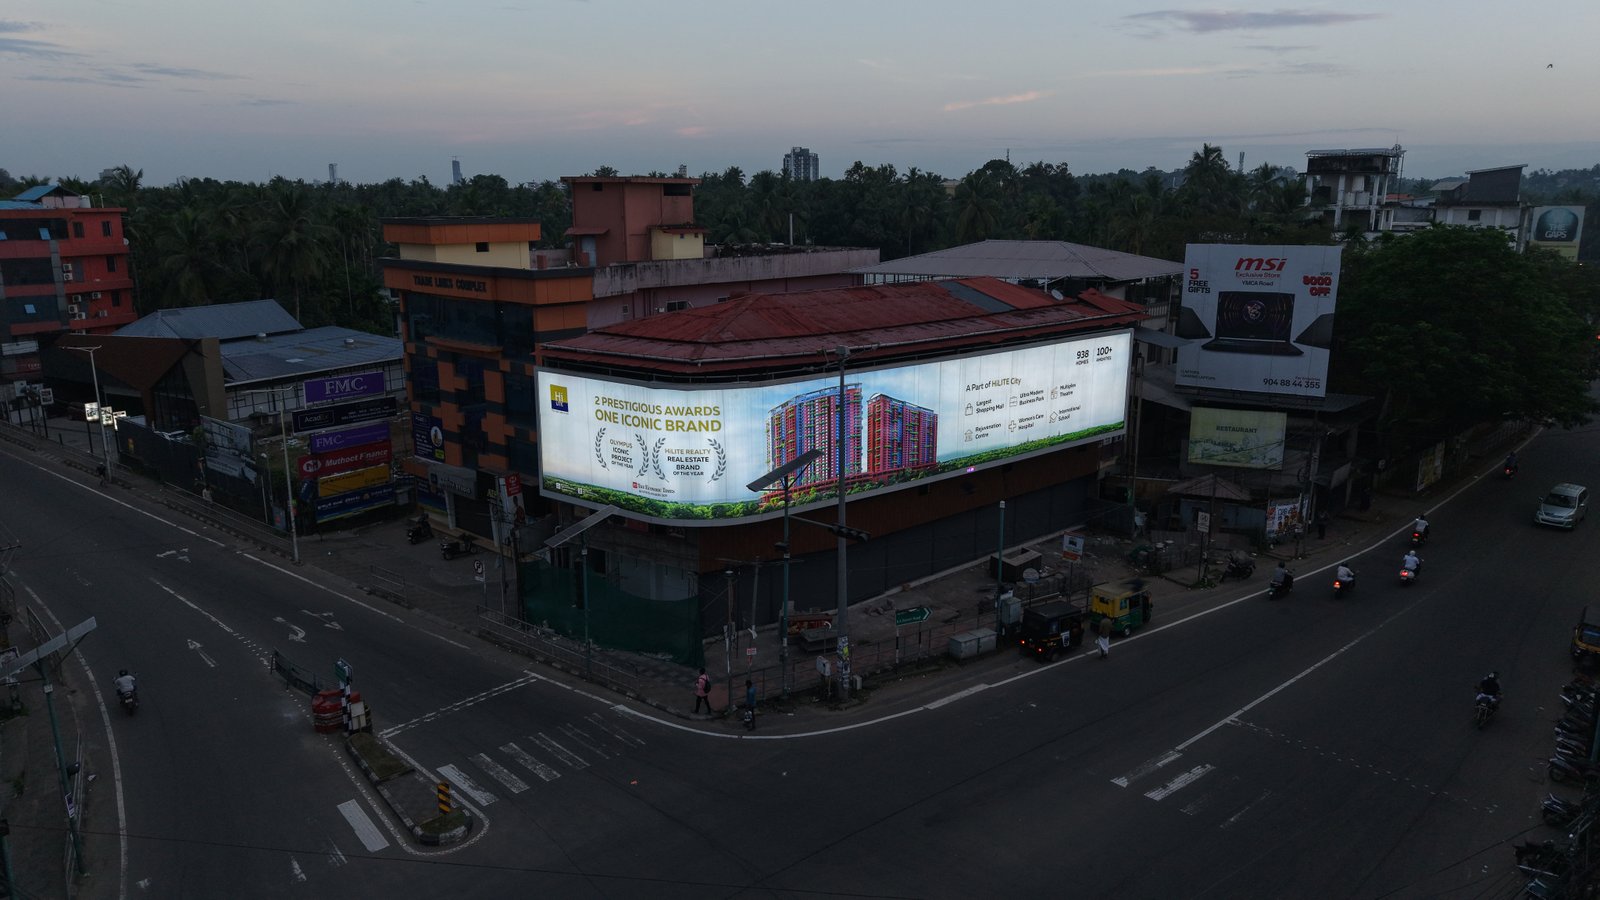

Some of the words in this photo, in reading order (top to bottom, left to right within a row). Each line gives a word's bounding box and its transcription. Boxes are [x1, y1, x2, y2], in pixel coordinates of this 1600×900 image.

[1235, 258, 1287, 271] msi
[1190, 268, 1199, 280] 5
[1309, 287, 1331, 296] OFF
[1077, 350, 1089, 359] 938
[1096, 346, 1112, 356] 100+
[972, 382, 984, 391] Part
[1011, 378, 1021, 386] City
[1304, 381, 1320, 389] 355
[595, 396, 600, 405] 2
[602, 397, 662, 414] PRESTIGIOUS
[664, 406, 720, 416] AWARDS
[976, 399, 992, 408] Largest
[976, 406, 995, 415] Shopping
[595, 409, 619, 424] ONE
[621, 414, 662, 430] ICONIC
[665, 420, 722, 432] BRAND
[975, 422, 1001, 433] Rejuvenation
[1018, 422, 1034, 431] Hospital
[1216, 425, 1258, 433] RESTAURANT
[975, 432, 989, 440] Centre
[610, 439, 632, 448] OLYMPUS
[612, 447, 630, 455] ICONIC
[325, 453, 358, 467] Muthoot
[360, 449, 388, 460] Finance
[611, 454, 632, 464] PROJECT
